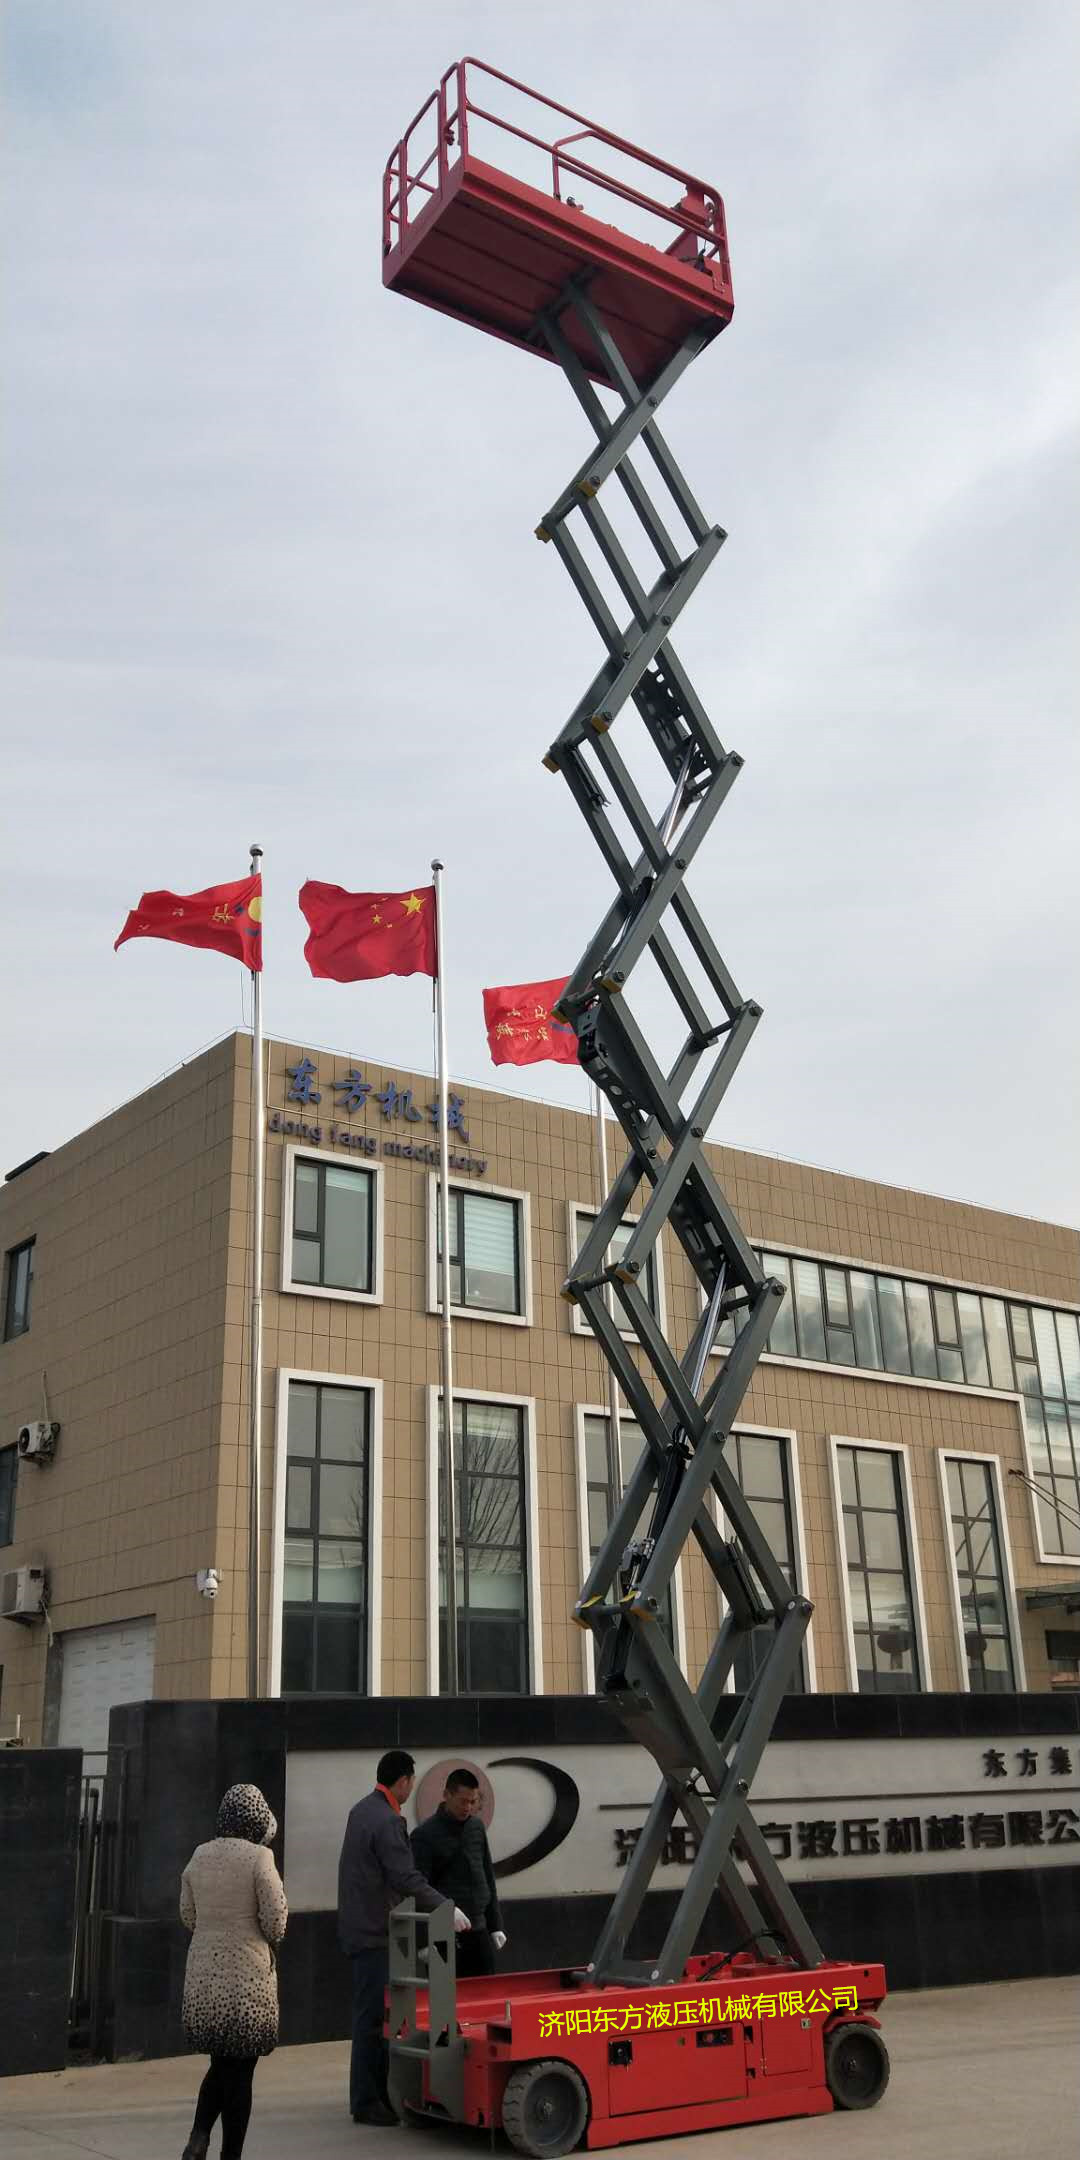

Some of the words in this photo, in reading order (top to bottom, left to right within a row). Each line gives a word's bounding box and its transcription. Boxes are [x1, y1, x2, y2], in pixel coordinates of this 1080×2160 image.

[269, 1112, 322, 1146] dong
[287, 1057, 471, 1143] 东方机械
